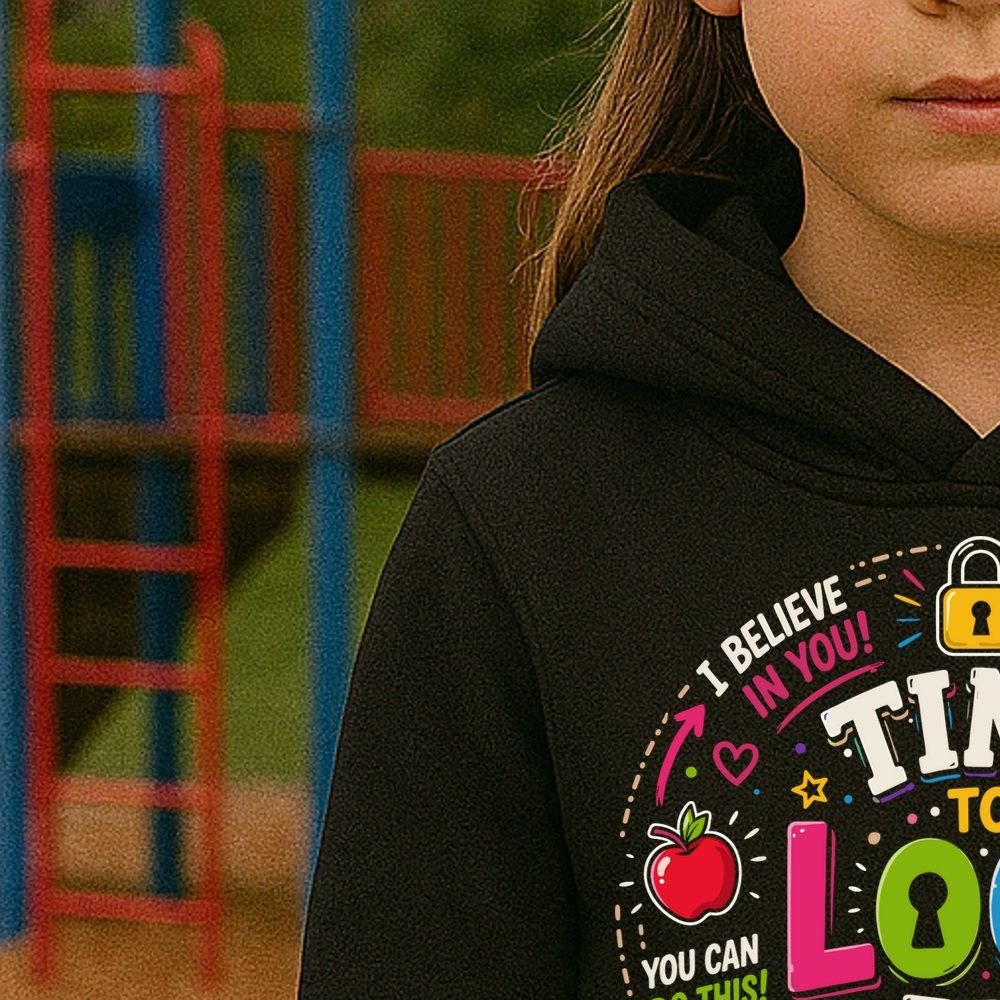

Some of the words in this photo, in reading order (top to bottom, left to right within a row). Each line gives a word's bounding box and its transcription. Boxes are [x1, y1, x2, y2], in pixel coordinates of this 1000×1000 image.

[696, 660, 729, 697] I
[720, 575, 847, 674] BELIEVE
[742, 664, 790, 718] IN
[784, 610, 873, 683] YOU!
[641, 949, 696, 989] YOU
[704, 933, 759, 974] CAN
